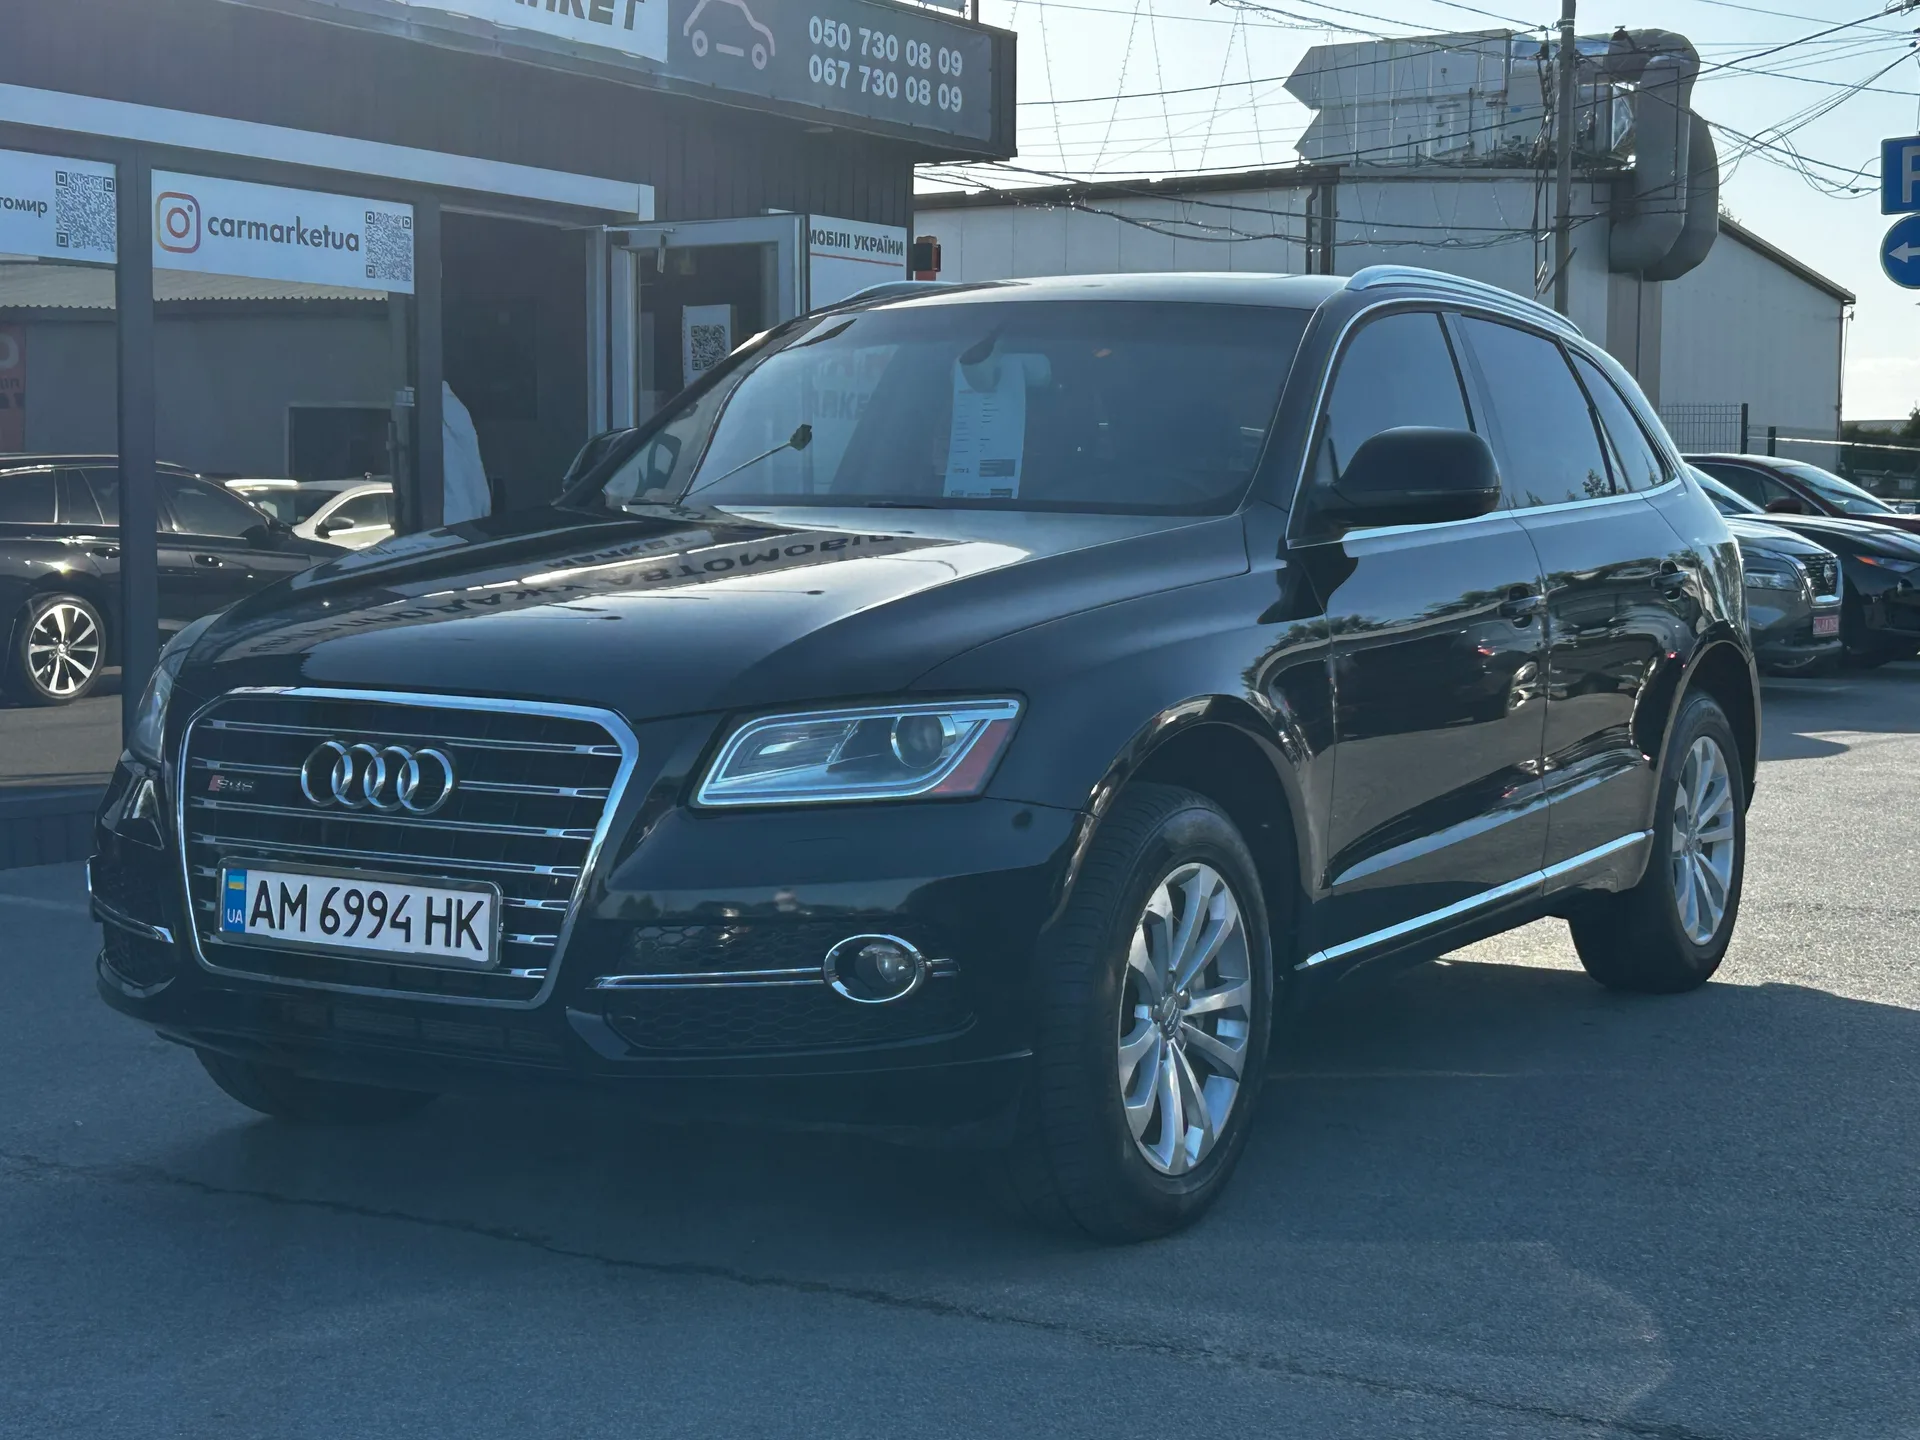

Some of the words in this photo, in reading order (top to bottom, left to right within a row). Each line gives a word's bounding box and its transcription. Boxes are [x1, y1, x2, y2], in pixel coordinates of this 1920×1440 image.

[809, 15, 851, 51] 050
[858, 27, 898, 62] 730
[905, 39, 931, 70] 08
[938, 47, 963, 77] 09
[809, 54, 851, 89] 067
[858, 65, 898, 99] 730
[905, 76, 931, 106] 08
[938, 83, 963, 113] 09
[207, 215, 360, 252] carmarketua
[853, 235, 904, 256] УКРАЇНИ
[227, 908, 243, 924] UA
[249, 880, 308, 932] AM
[320, 886, 411, 943] 6994
[424, 896, 485, 951] HK
